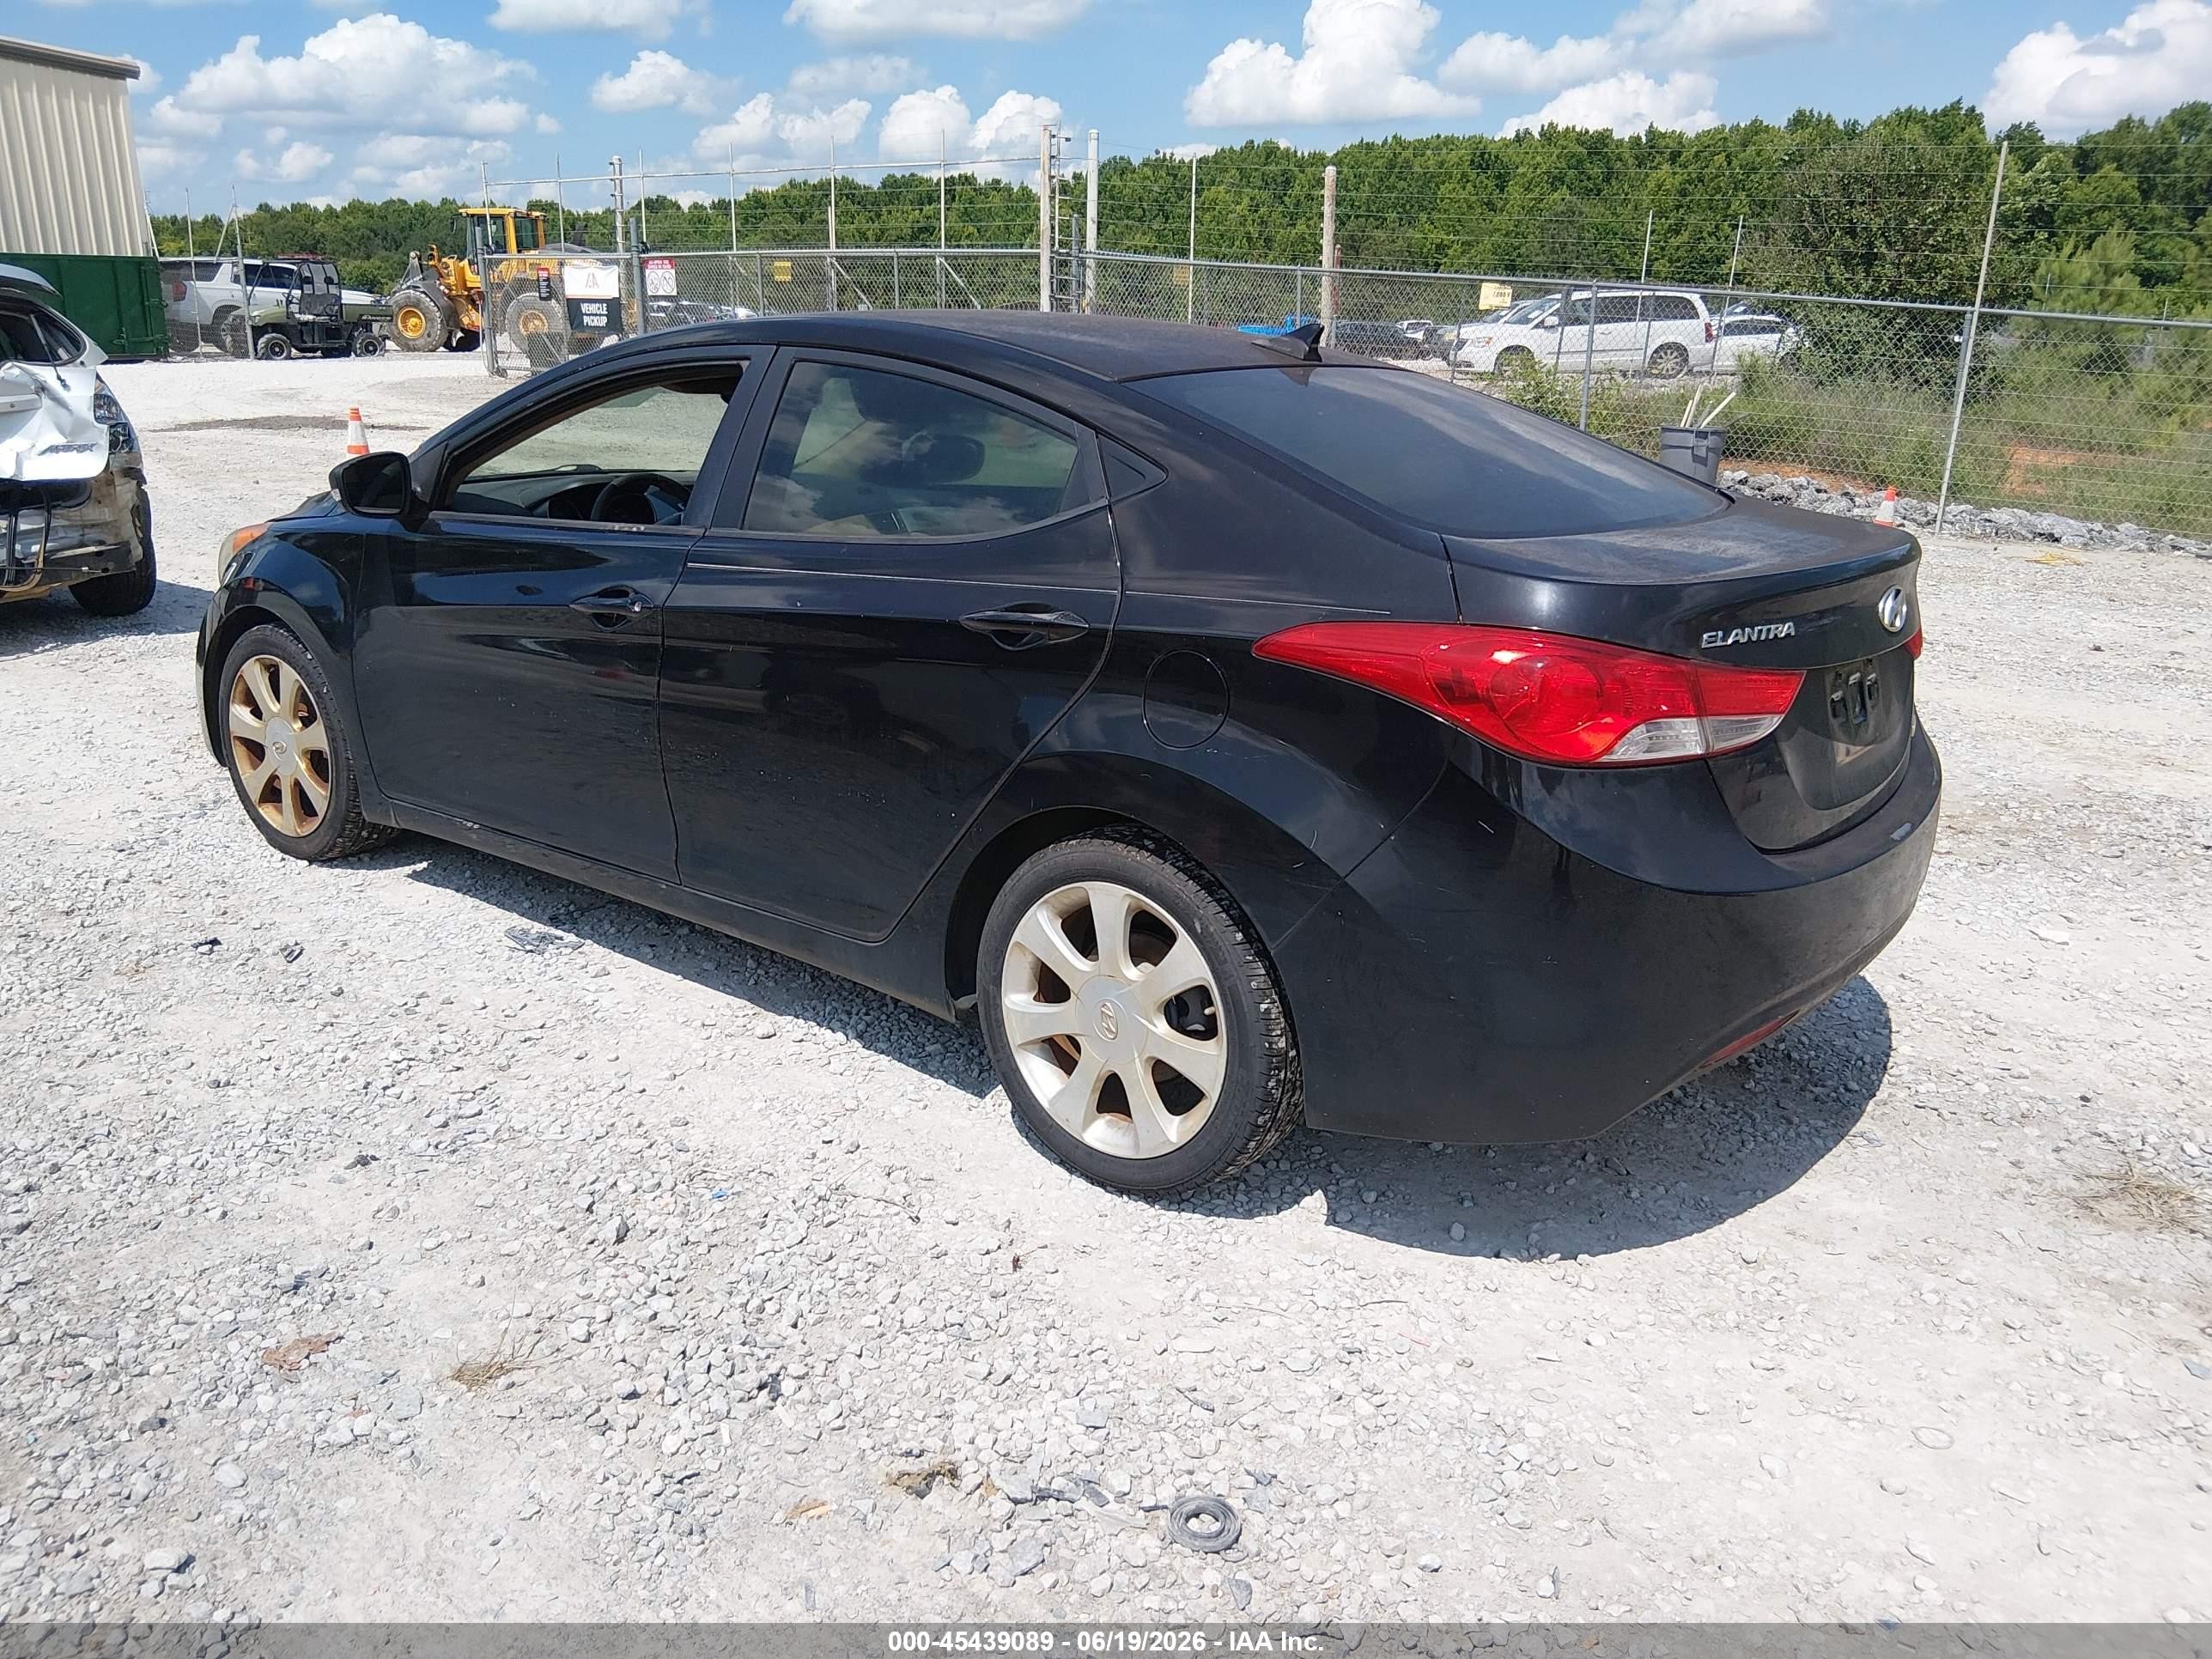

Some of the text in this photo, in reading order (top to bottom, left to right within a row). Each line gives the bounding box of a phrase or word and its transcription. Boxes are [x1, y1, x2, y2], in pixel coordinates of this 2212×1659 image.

[580, 301, 608, 314] VEHICLE
[583, 315, 608, 327] PICKUP
[1701, 622, 1796, 648] ELANTRA
